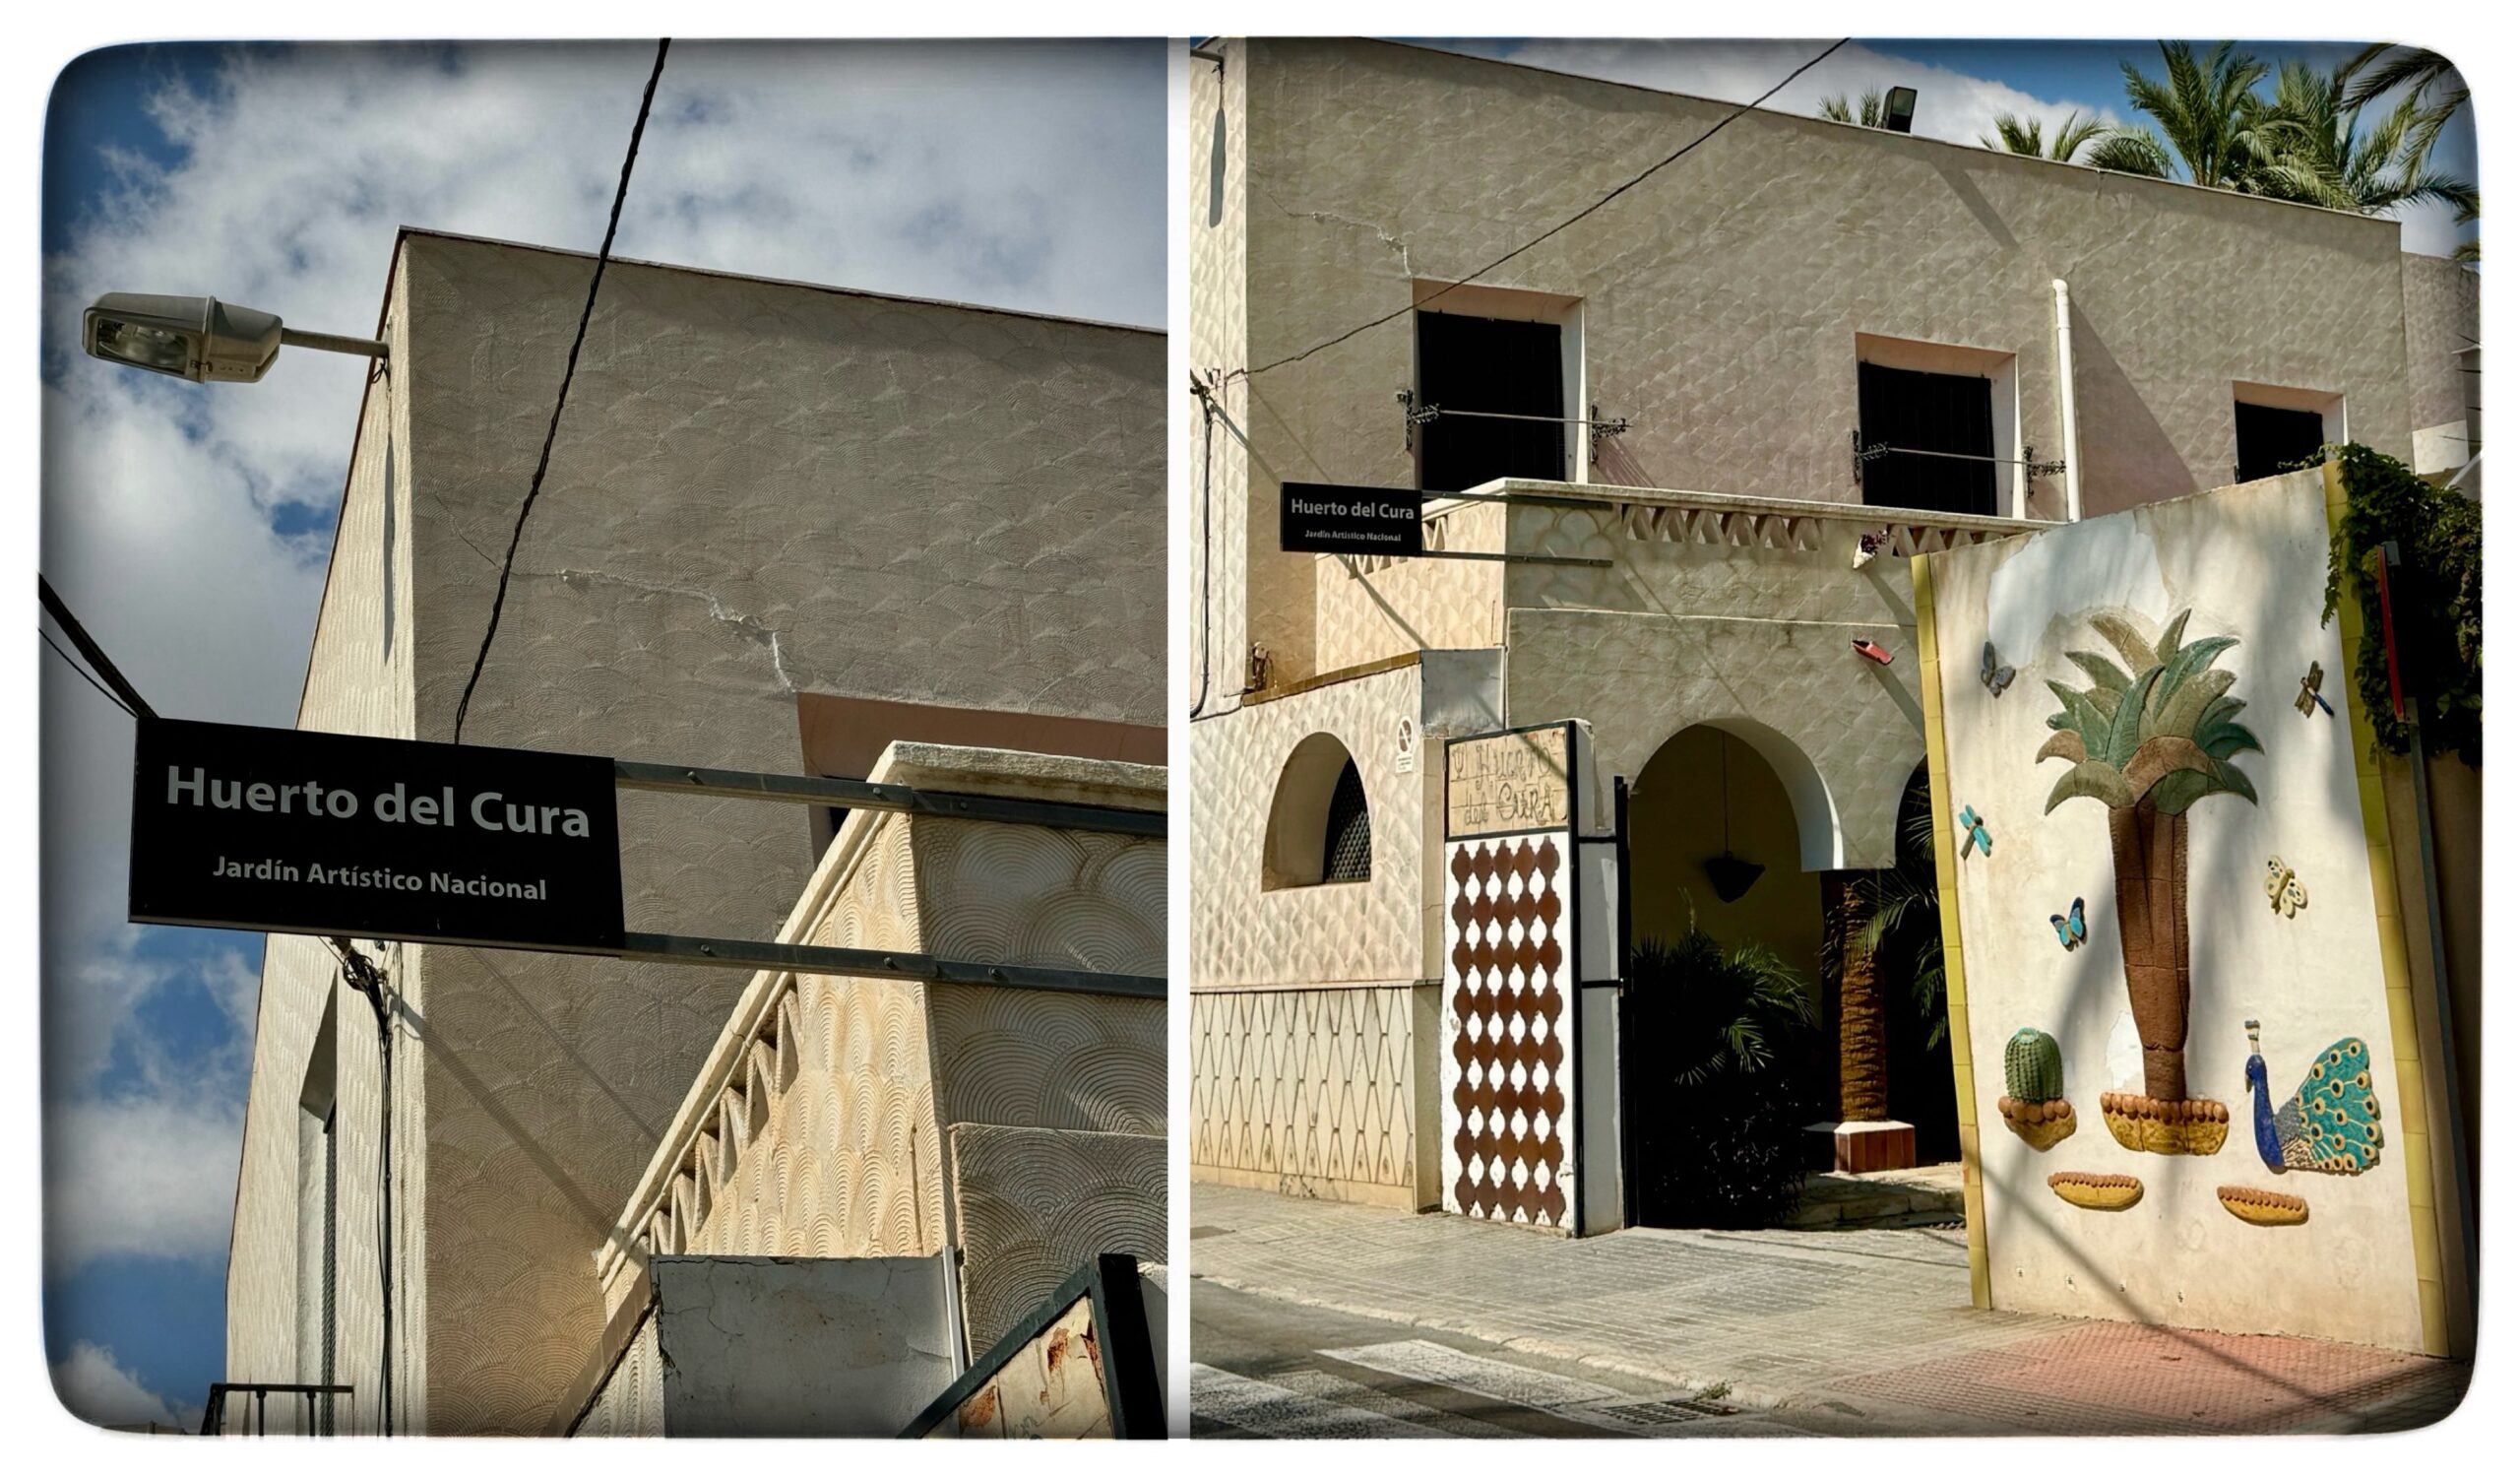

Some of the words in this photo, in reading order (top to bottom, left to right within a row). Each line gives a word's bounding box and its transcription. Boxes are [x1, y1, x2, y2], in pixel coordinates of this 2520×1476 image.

[1292, 498, 1347, 515] Huerto
[1352, 501, 1375, 517] del
[1379, 504, 1414, 519] Cura
[1332, 531, 1365, 540] Artístico
[168, 766, 357, 818] Huerto
[374, 783, 454, 826] del
[472, 793, 590, 837] Cura
[214, 857, 298, 881] Jardín
[307, 864, 422, 890] Artístico
[430, 872, 545, 900] Nacional
